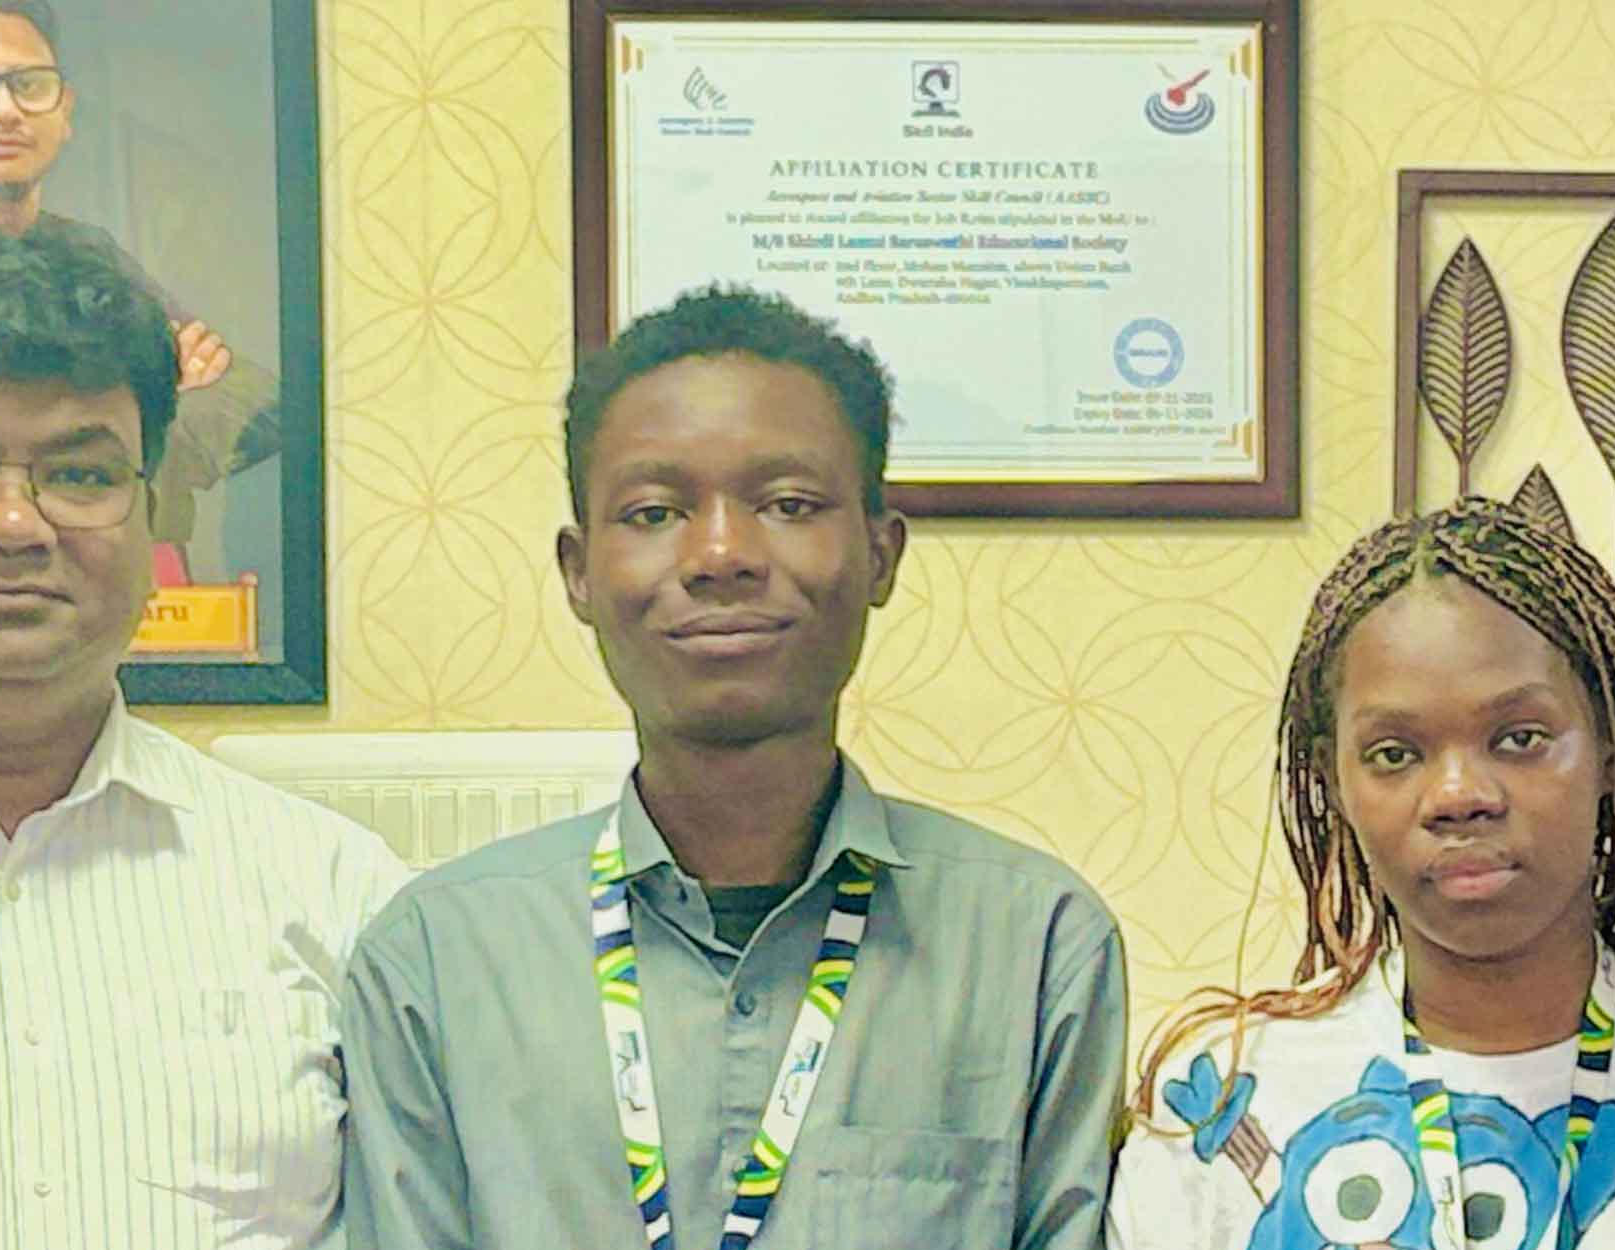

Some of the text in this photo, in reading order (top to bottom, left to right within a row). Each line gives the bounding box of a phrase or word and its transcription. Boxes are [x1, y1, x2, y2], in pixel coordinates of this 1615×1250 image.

[903, 125, 974, 138] Skill India
[769, 159, 1099, 178] AFFILIATION CERTIFICATE
[978, 234, 1068, 250] Educational
[1072, 234, 1128, 250] Society
